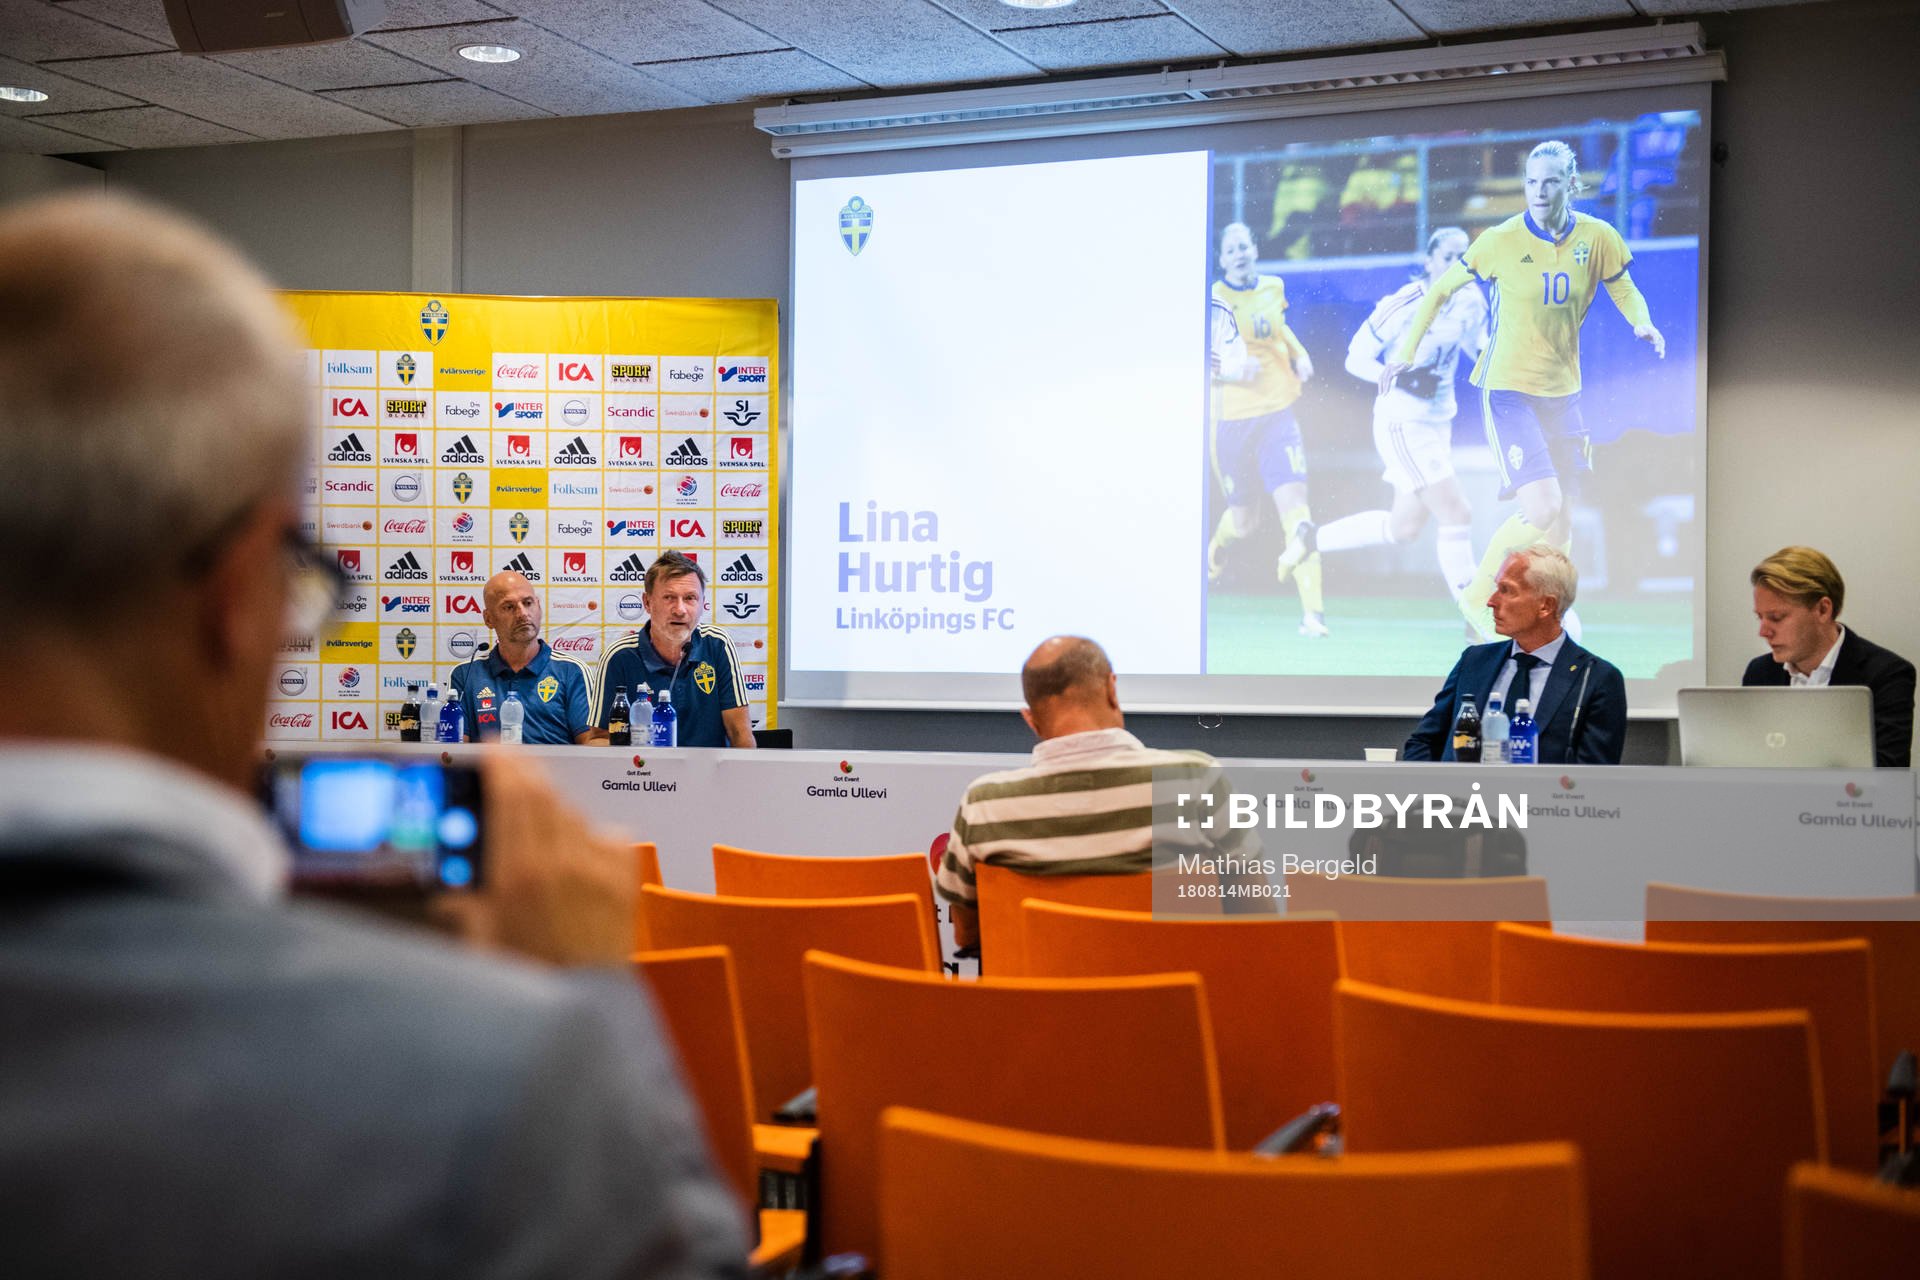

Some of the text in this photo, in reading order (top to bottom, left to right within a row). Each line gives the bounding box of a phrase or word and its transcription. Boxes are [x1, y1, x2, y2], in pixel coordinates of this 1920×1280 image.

[1541, 272, 1570, 305] 10
[328, 362, 372, 374] Folksam
[559, 363, 594, 381] ICA
[612, 365, 651, 377] SPORT
[670, 370, 704, 382] Fabege
[332, 398, 368, 416] ICA
[386, 401, 426, 413] SPORT
[446, 405, 480, 417] Fabege
[608, 407, 655, 417] Scandic
[736, 400, 749, 412] SJ
[328, 451, 371, 462] adidas
[441, 453, 484, 463] adidas
[554, 454, 596, 465] adidas
[666, 455, 708, 466] adidas
[325, 481, 374, 492] Scandic
[553, 484, 598, 494] Folksam
[723, 521, 762, 533] SPORT
[839, 500, 939, 543] Lina
[558, 524, 592, 536] Fabege
[671, 520, 705, 537] ICA
[385, 569, 428, 580] adidas
[610, 571, 646, 581] adida
[721, 571, 763, 582] adidas
[838, 550, 994, 603] Hurtig
[446, 596, 481, 613] ICA
[736, 593, 748, 605] SJ
[836, 607, 1014, 634] Linköpings FC
[327, 640, 372, 648] #viärsverige
[384, 677, 428, 687] Folksam
[332, 712, 368, 729] ICA
[478, 714, 496, 723] ICA
[602, 780, 677, 792] Gamla Ullevi
[807, 786, 887, 799] Gamla Ullevi
[1575, 806, 1621, 819] Ullevi
[1798, 812, 1912, 829] Gamla Ullevi
